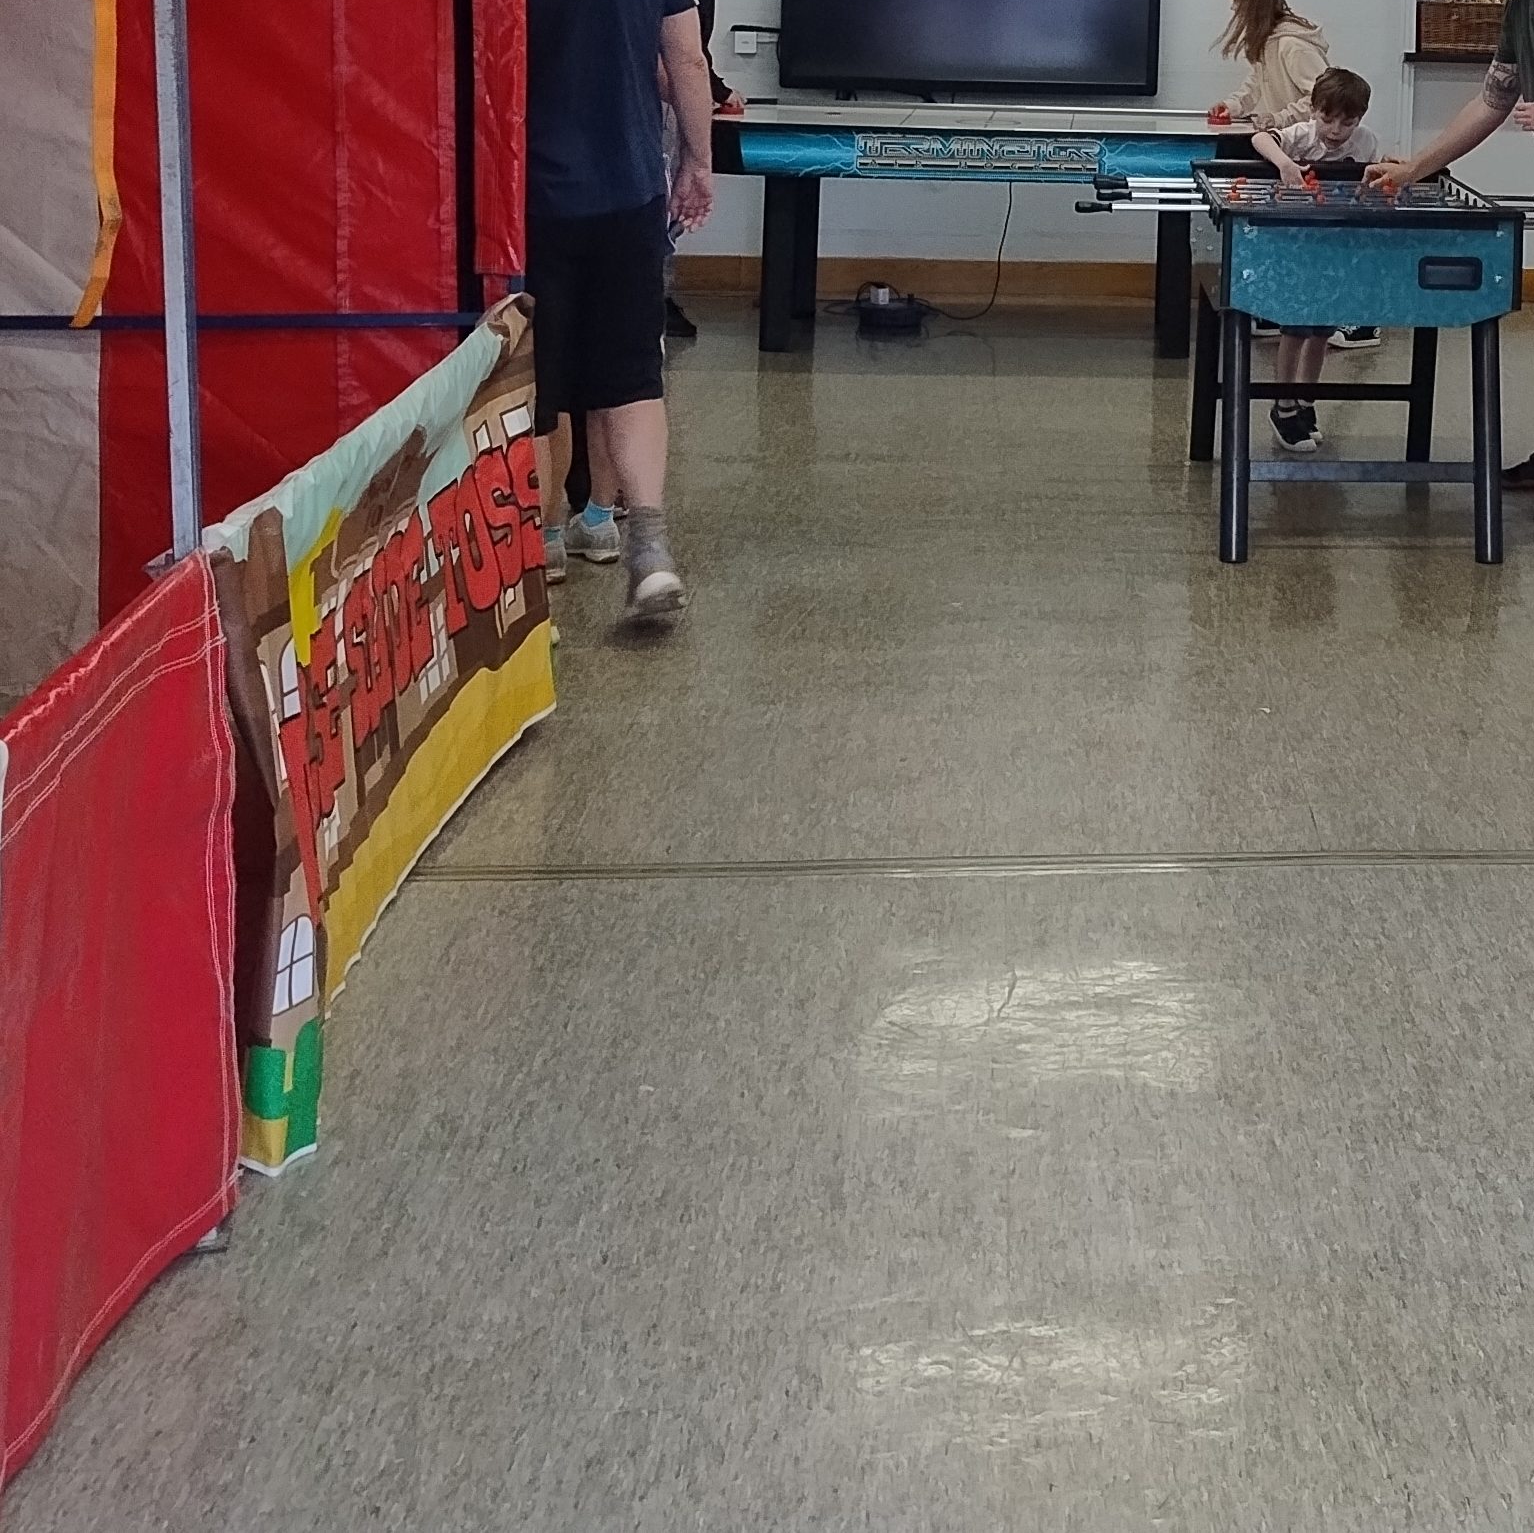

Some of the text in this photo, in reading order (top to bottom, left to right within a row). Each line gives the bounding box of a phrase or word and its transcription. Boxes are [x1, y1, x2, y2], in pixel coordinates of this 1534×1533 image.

[868, 158, 1090, 173] AIR HOCKEY
[427, 436, 547, 639] TOSS
